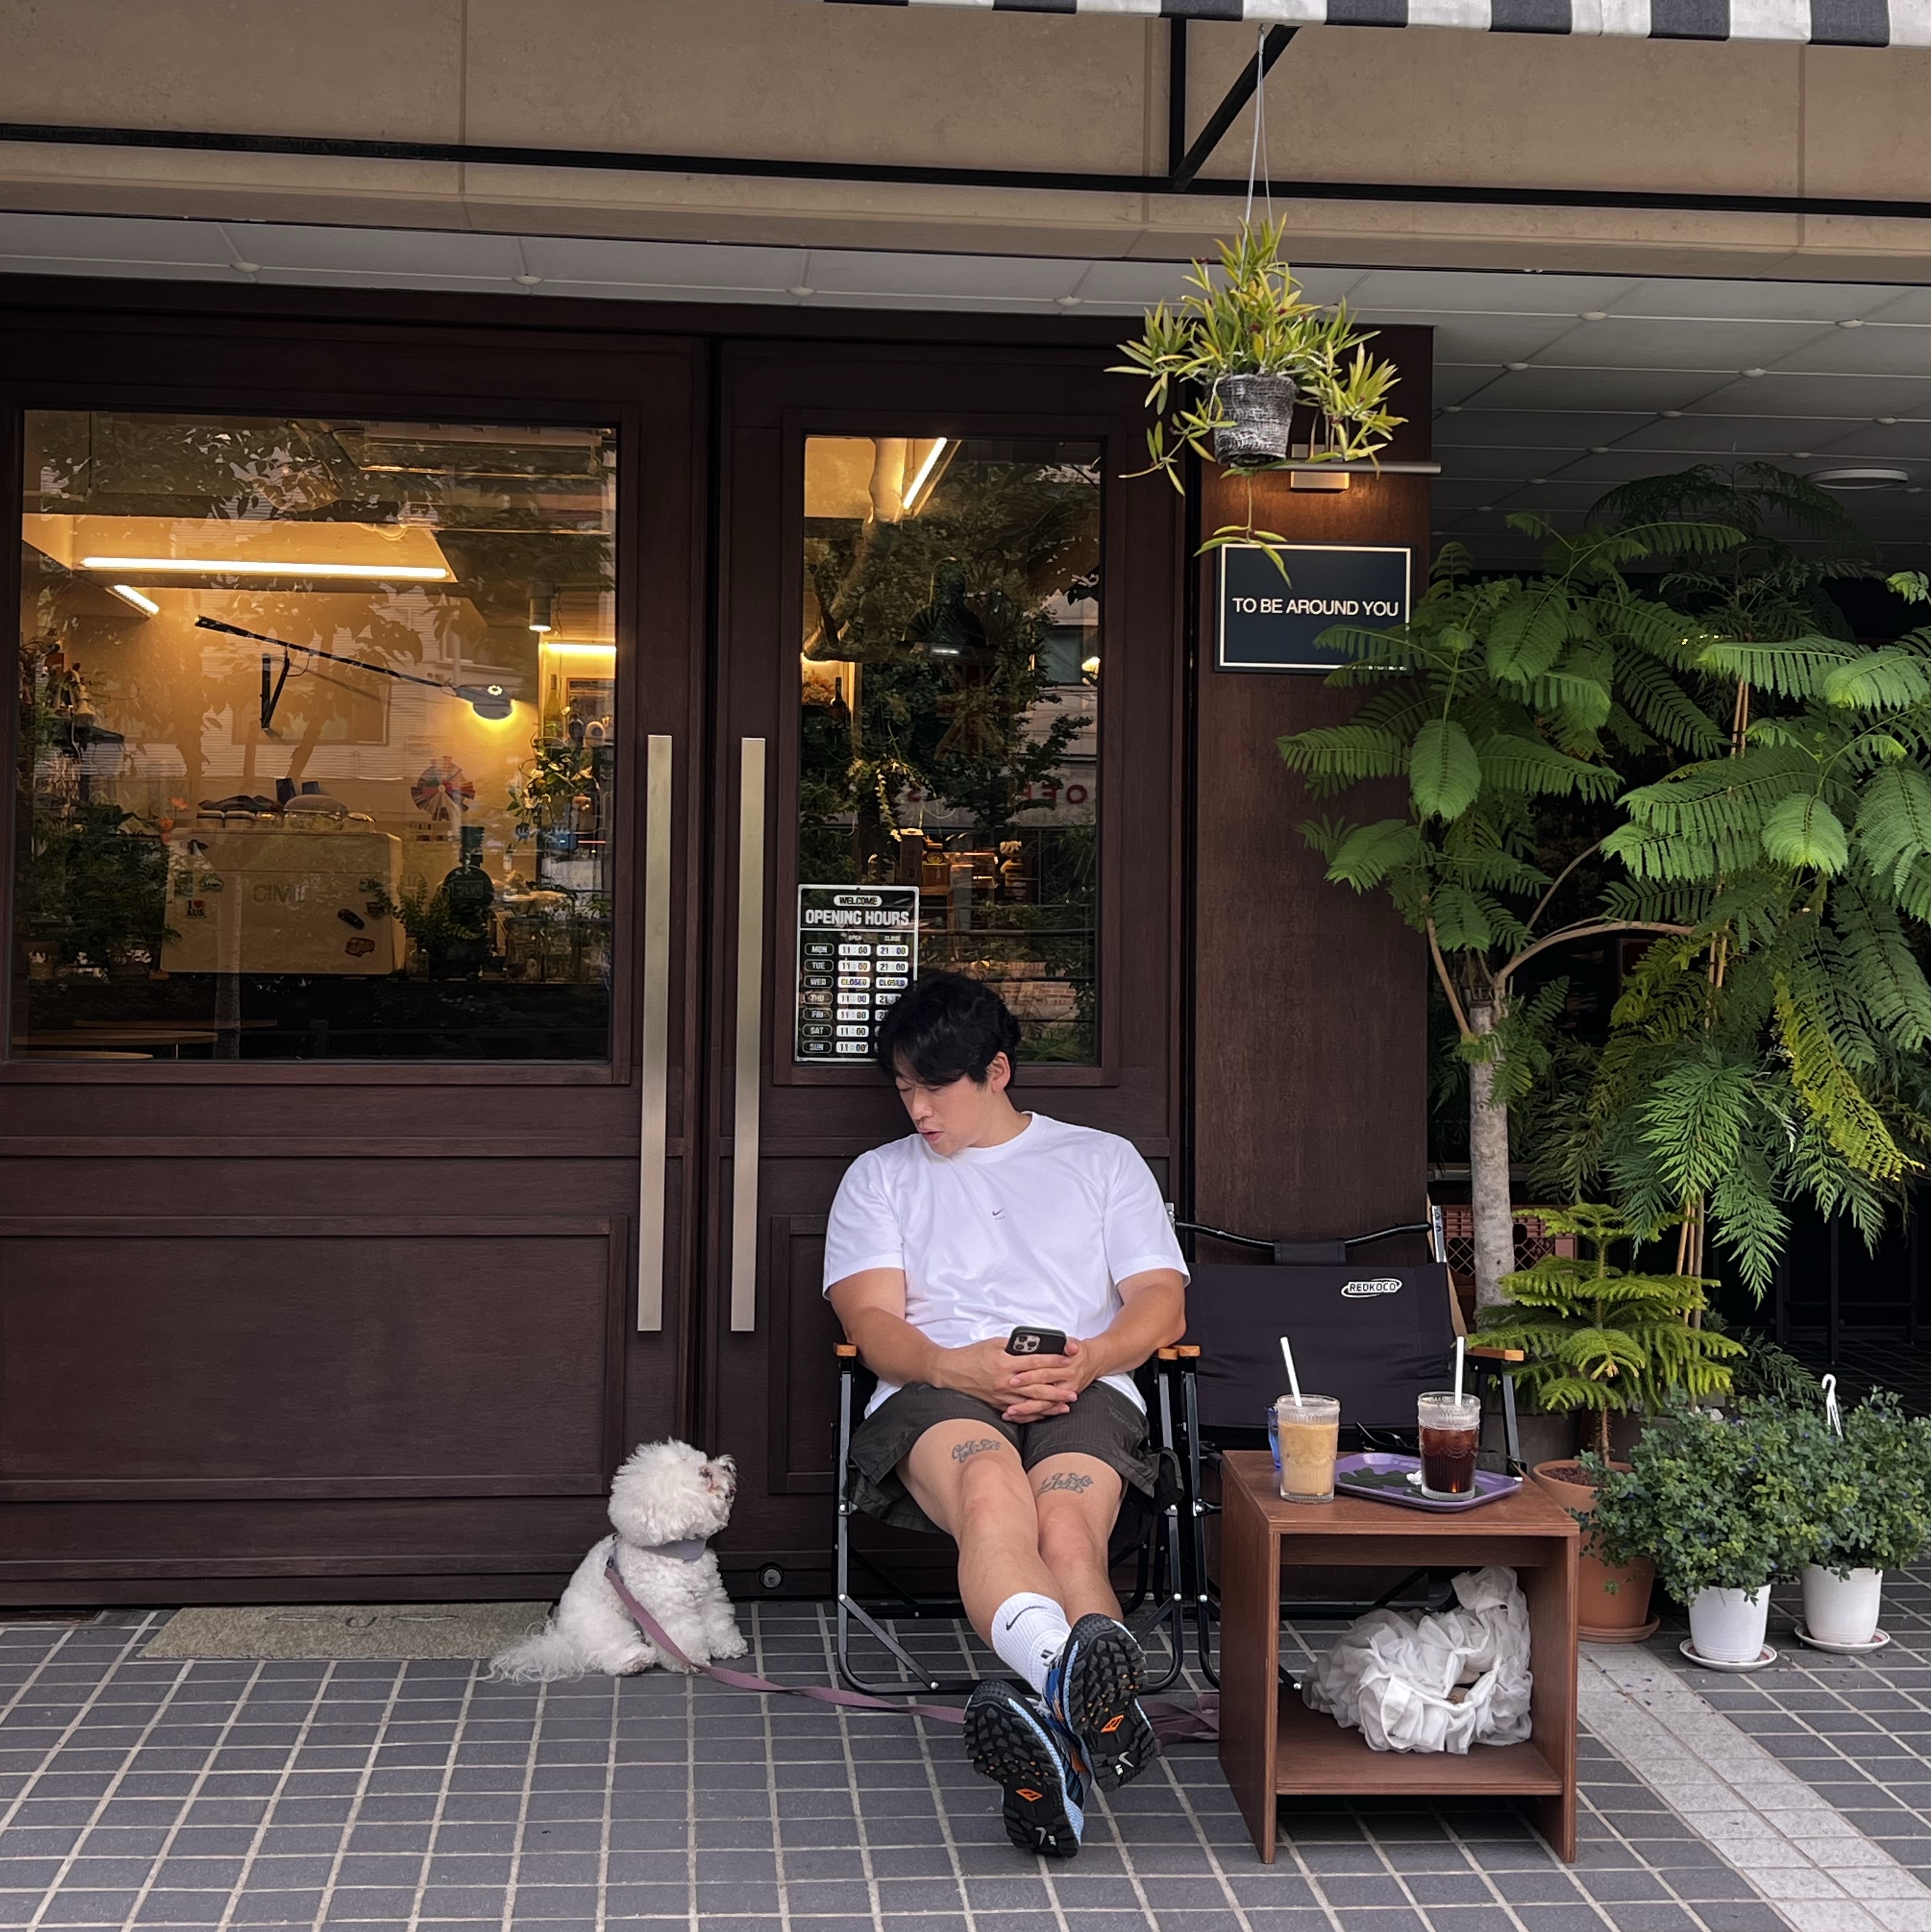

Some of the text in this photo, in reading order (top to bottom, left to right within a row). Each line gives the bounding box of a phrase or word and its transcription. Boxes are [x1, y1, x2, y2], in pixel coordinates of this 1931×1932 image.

[1232, 598, 1399, 616] TO BE AROUND YOU
[839, 897, 878, 905] WELCOME
[805, 909, 910, 926] OPENING HOURS
[811, 961, 825, 970] TUE
[810, 1026, 824, 1035] SAT
[1348, 1282, 1396, 1293] REDKOCO
